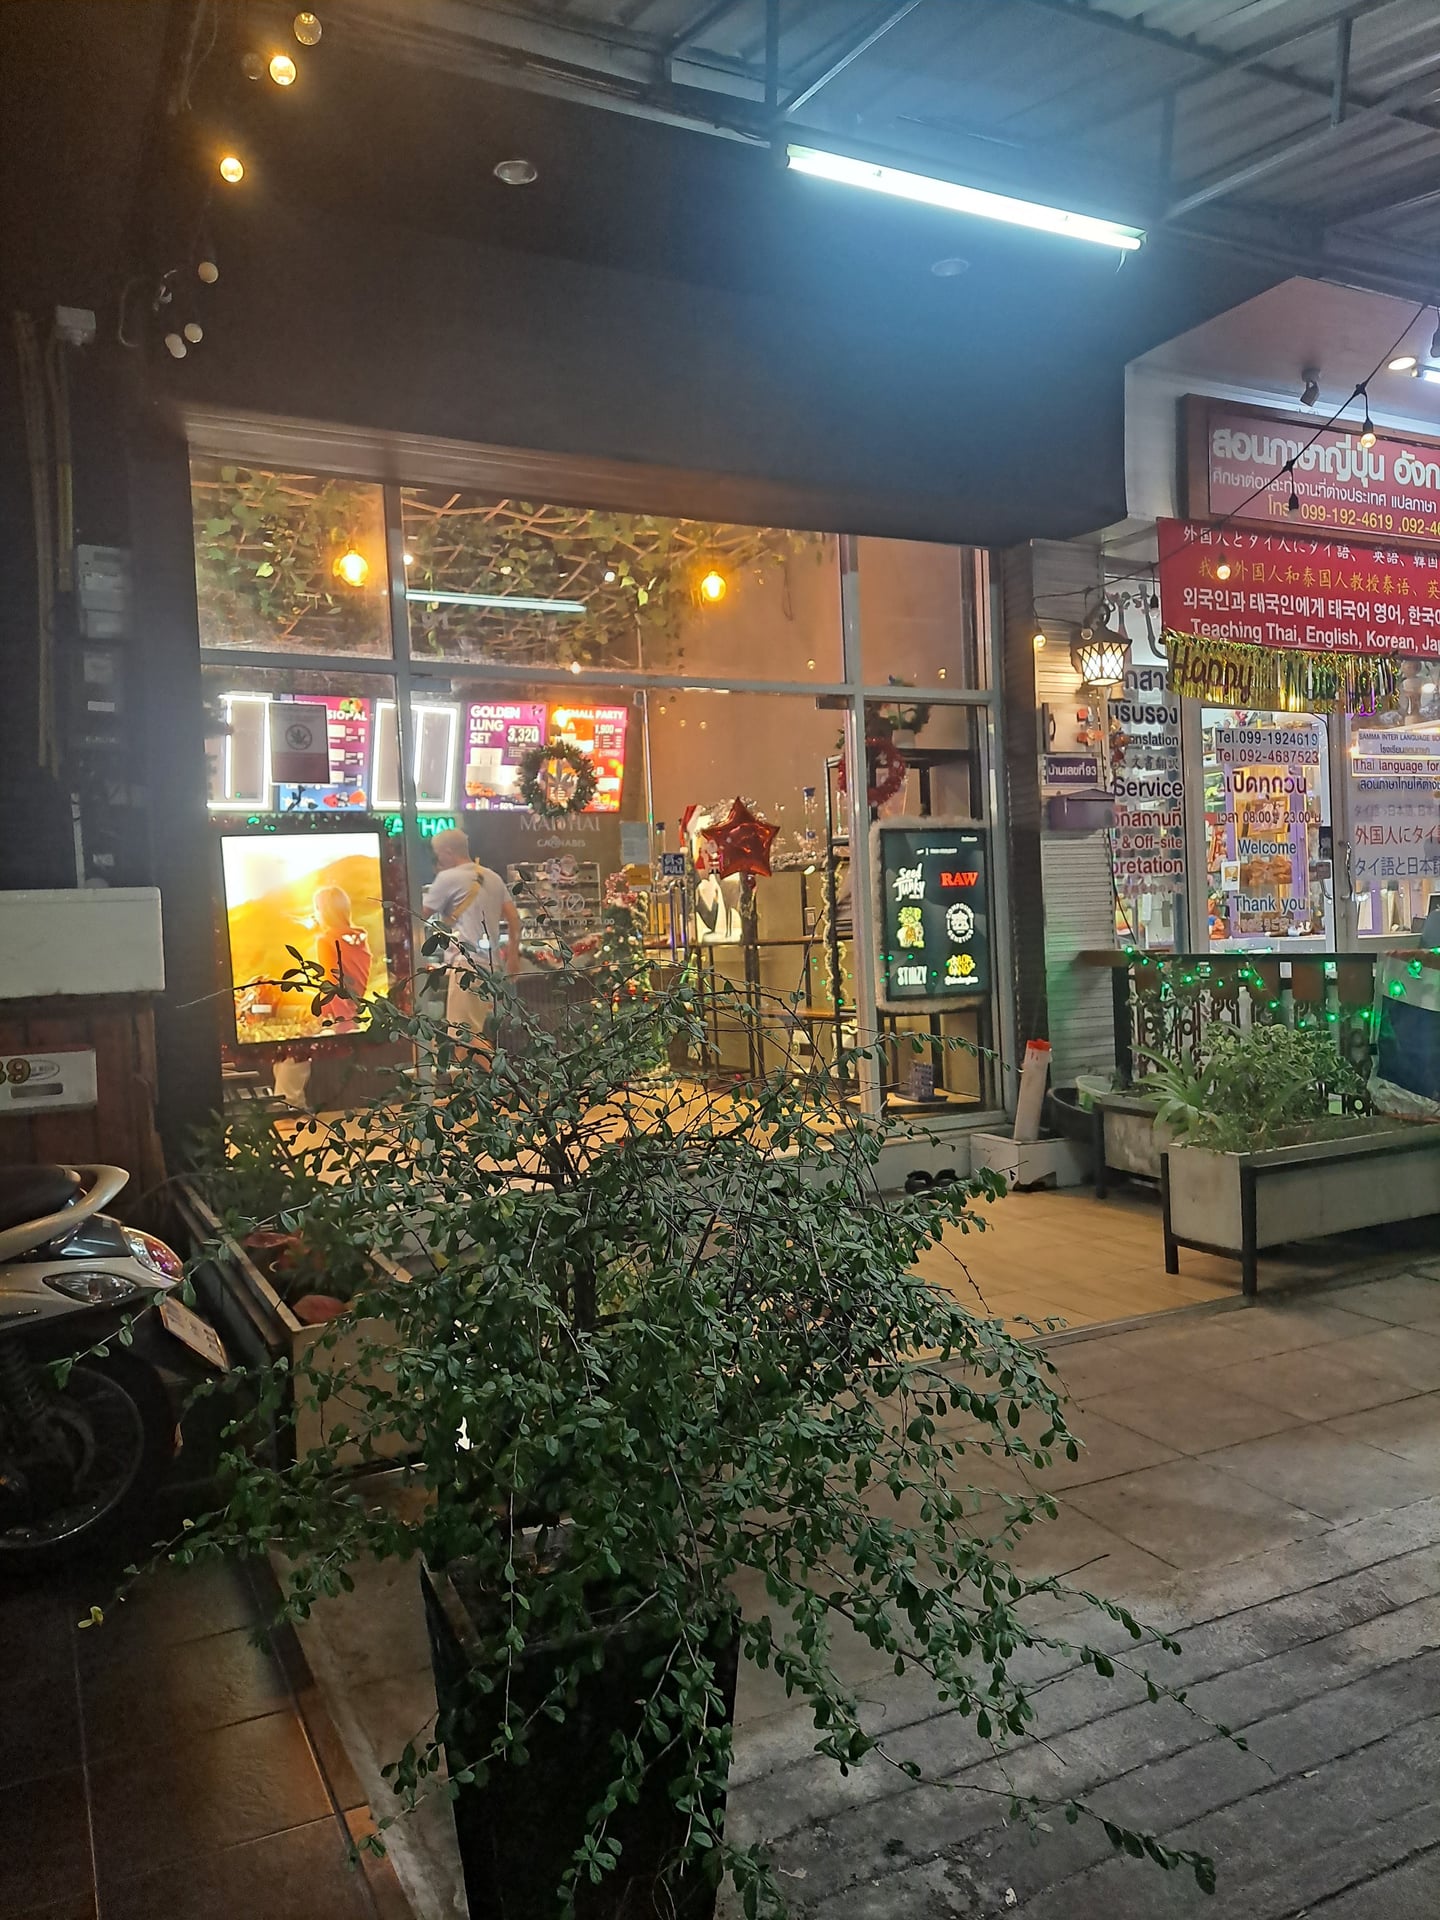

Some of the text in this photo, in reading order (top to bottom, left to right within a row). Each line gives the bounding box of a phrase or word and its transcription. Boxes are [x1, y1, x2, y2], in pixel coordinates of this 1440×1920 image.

[1302, 503, 1393, 530] 099-192-4619
[1183, 587, 1246, 613] 외국인과
[1249, 592, 1325, 619] 태국인에게
[1328, 598, 1370, 622] 태국어
[1373, 602, 1405, 626] 영어,
[1190, 618, 1262, 643] Teaching
[1265, 622, 1301, 645] Thai,
[1306, 625, 1362, 650] English,
[1366, 629, 1419, 654] Korean,
[470, 705, 521, 719] GOLDEN
[470, 719, 505, 731] LUNG
[469, 726, 540, 744] SET 3,320
[1217, 729, 1318, 746] Tel.099-1924619
[1217, 747, 1319, 763] Tel.092-4687523
[1086, 765, 1097, 776] 93
[1354, 758, 1375, 771] Thai
[1379, 759, 1423, 774] language
[1112, 776, 1183, 797] Service
[1226, 766, 1308, 801] เปิดทุกวัน
[1243, 811, 1271, 824] 08.00
[1284, 812, 1310, 824] 23.00
[1134, 836, 1183, 849] Off-site
[1239, 840, 1297, 855] Welcome
[940, 872, 979, 887] RAW
[1233, 896, 1307, 914] Thank you
